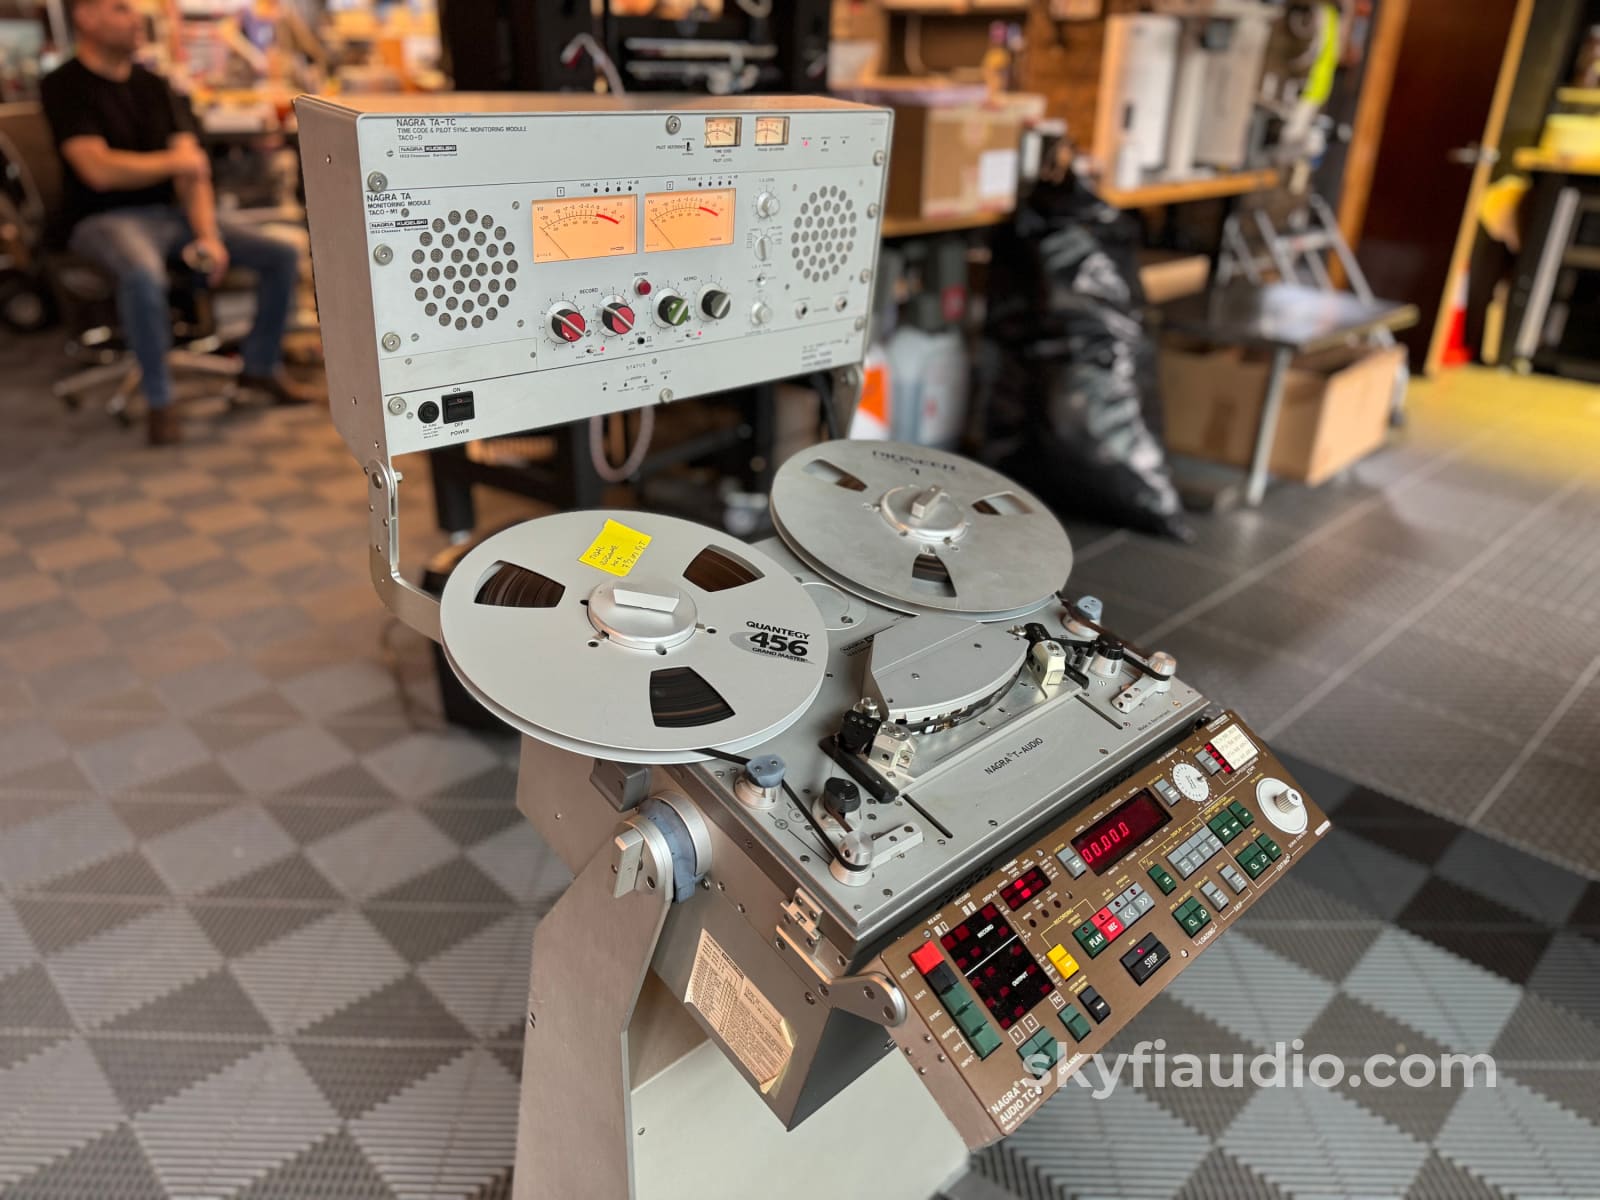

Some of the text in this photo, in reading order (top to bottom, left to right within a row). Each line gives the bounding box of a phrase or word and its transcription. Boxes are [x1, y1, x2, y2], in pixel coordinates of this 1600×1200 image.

[396, 118, 426, 126] NAGRA
[367, 194, 397, 202] NAGRA
[872, 450, 956, 471] PIONEER
[746, 620, 810, 640] QUANTEGY
[750, 632, 808, 656] 456
[752, 647, 777, 656] GRAND
[1012, 737, 1043, 758] T-AUDIO
[953, 891, 971, 906] RECORD
[926, 912, 942, 925] READY
[976, 923, 994, 938] RECORD
[1107, 921, 1118, 932] REC
[1087, 931, 1104, 948] PLAY
[1197, 926, 1216, 945] LOADING
[1143, 951, 1160, 969] STOP
[899, 965, 916, 980] READY
[1010, 970, 1029, 987] OUTPUT
[914, 989, 926, 1000] SAFE
[1052, 995, 1062, 1004] TC
[928, 1009, 942, 1021] SYNC
[941, 1025, 957, 1040] REPRO
[960, 1053, 975, 1068] INPUT
[990, 1085, 1020, 1115] NAGRA
[998, 1087, 1036, 1125] AUDIO TC
